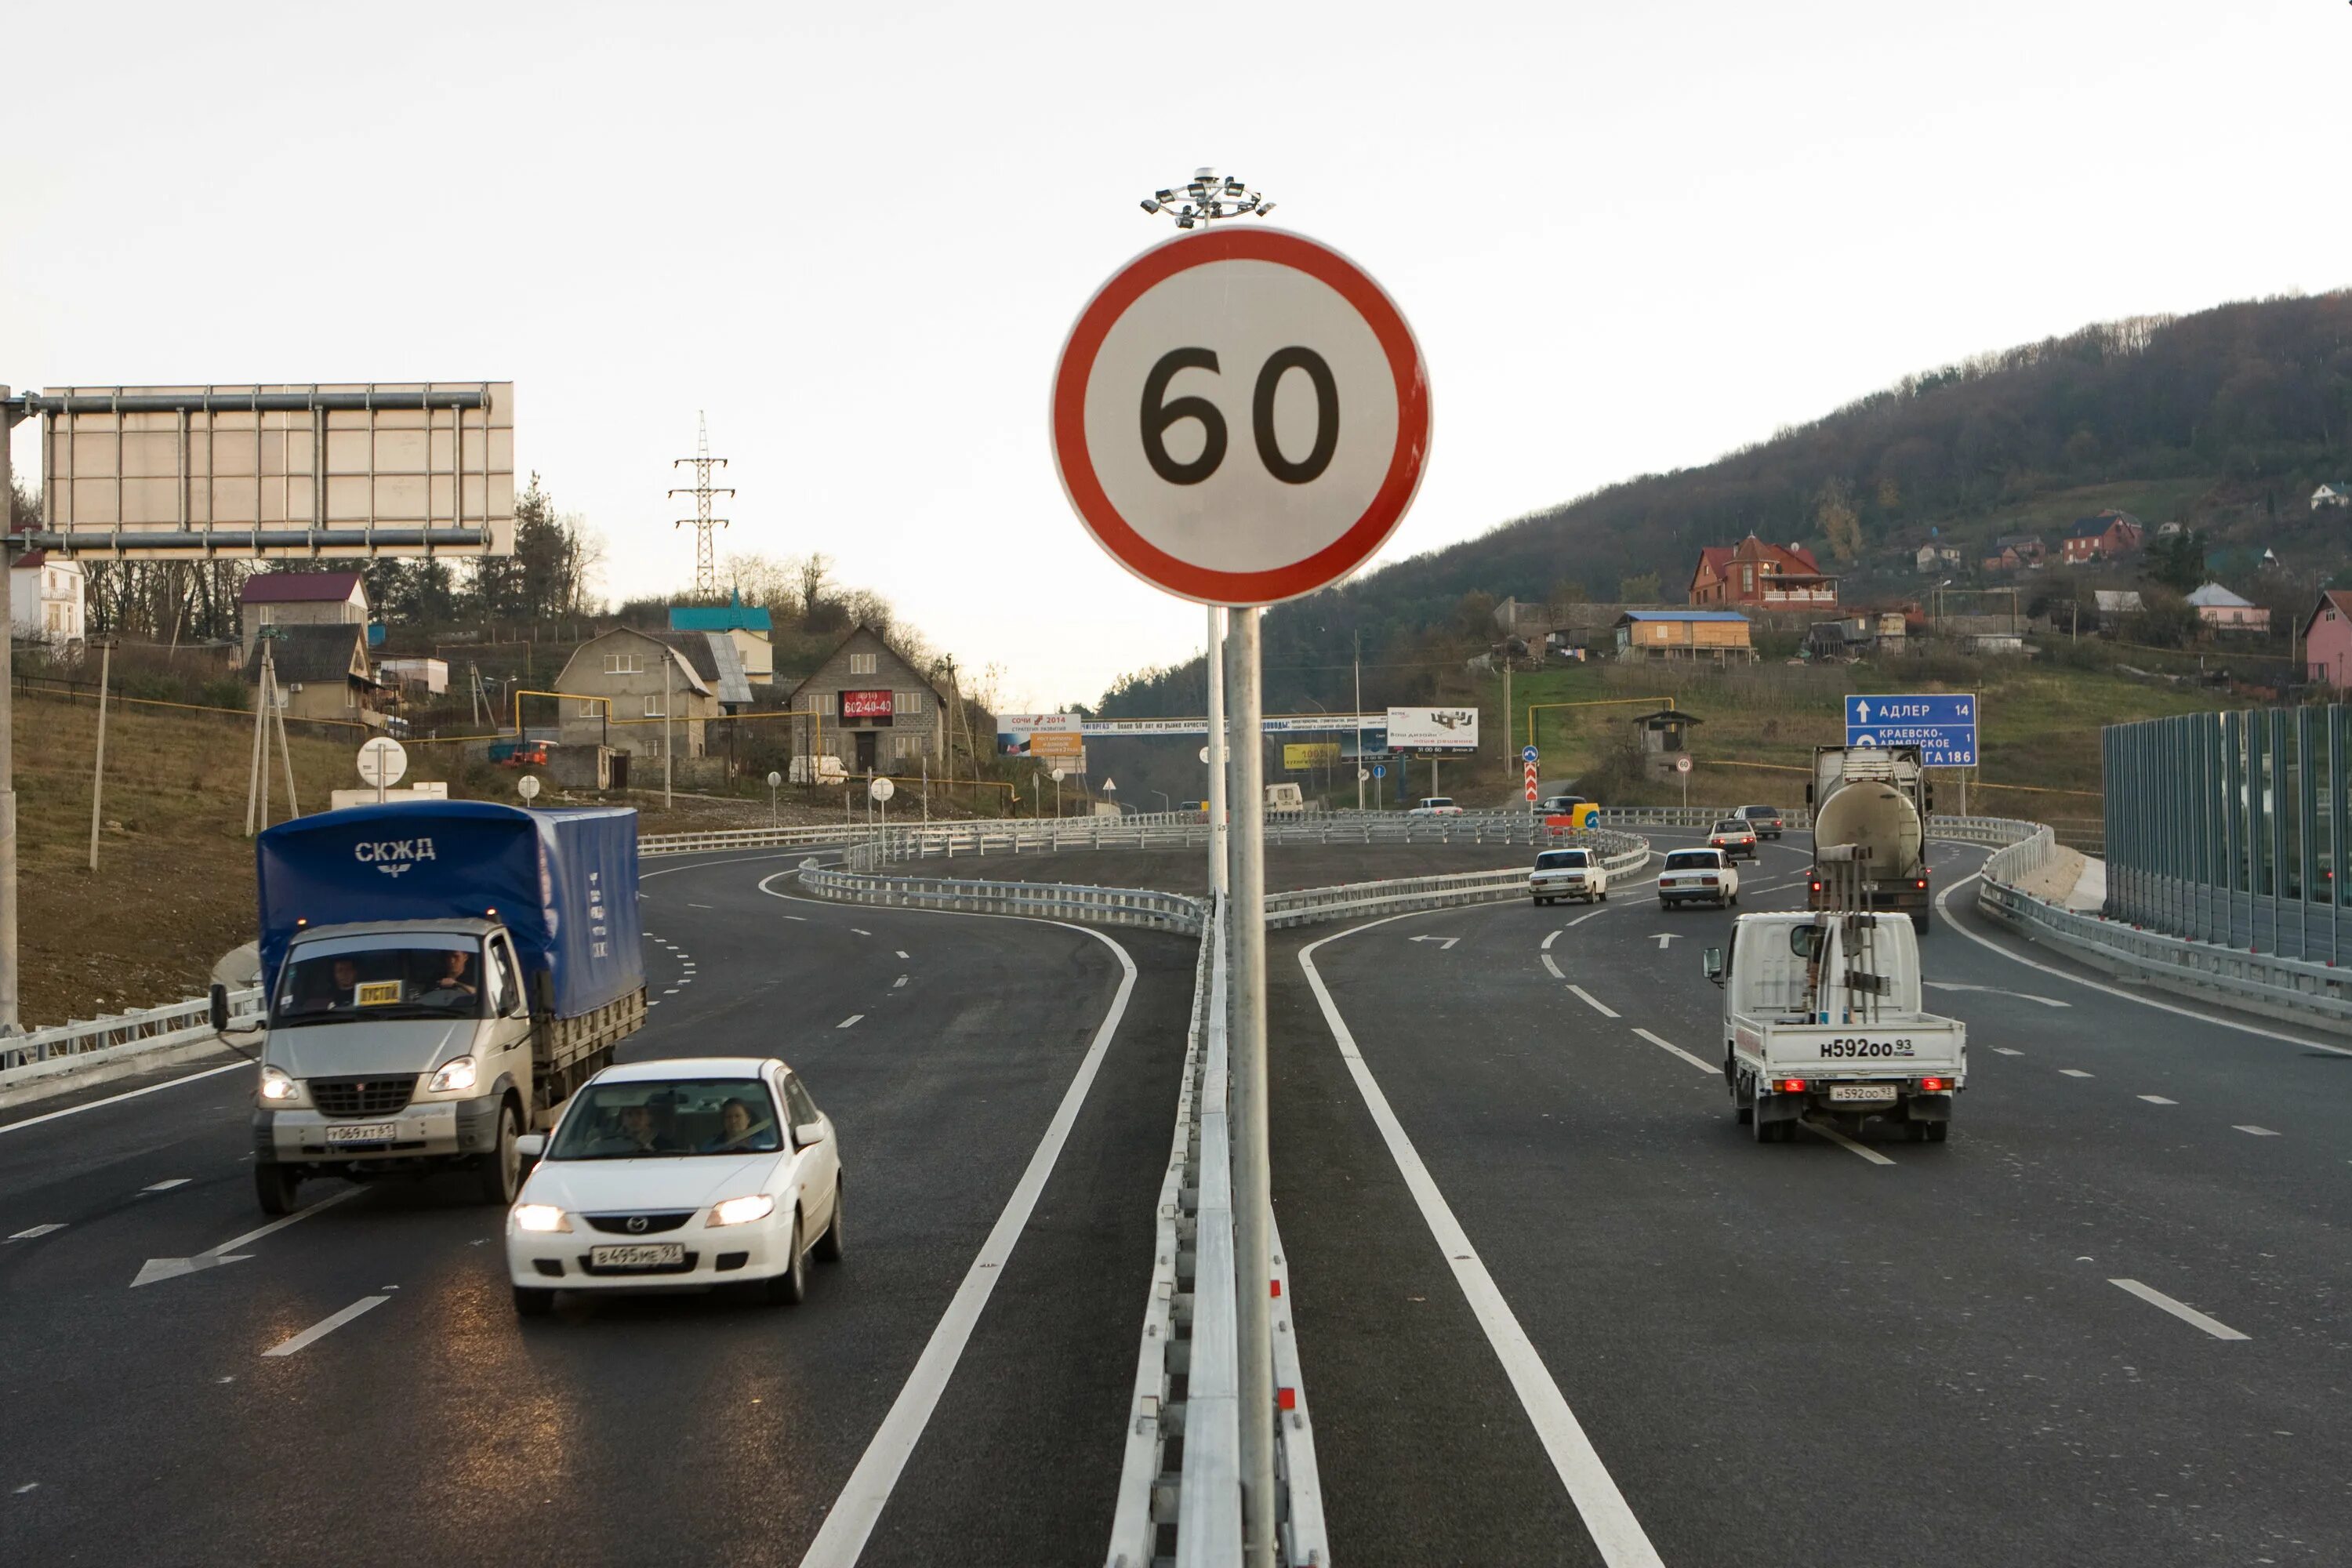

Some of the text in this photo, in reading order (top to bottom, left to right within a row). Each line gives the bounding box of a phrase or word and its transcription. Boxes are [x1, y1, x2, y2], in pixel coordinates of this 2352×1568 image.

[1140, 345, 1340, 485] 60
[1879, 704, 1969, 718] АДЛЕР 14
[1879, 729, 1971, 742] КРАЕВСКО- 1
[1947, 751, 1971, 763] 186
[354, 837, 437, 862] СКЖД
[1896, 1039, 1912, 1050] 93
